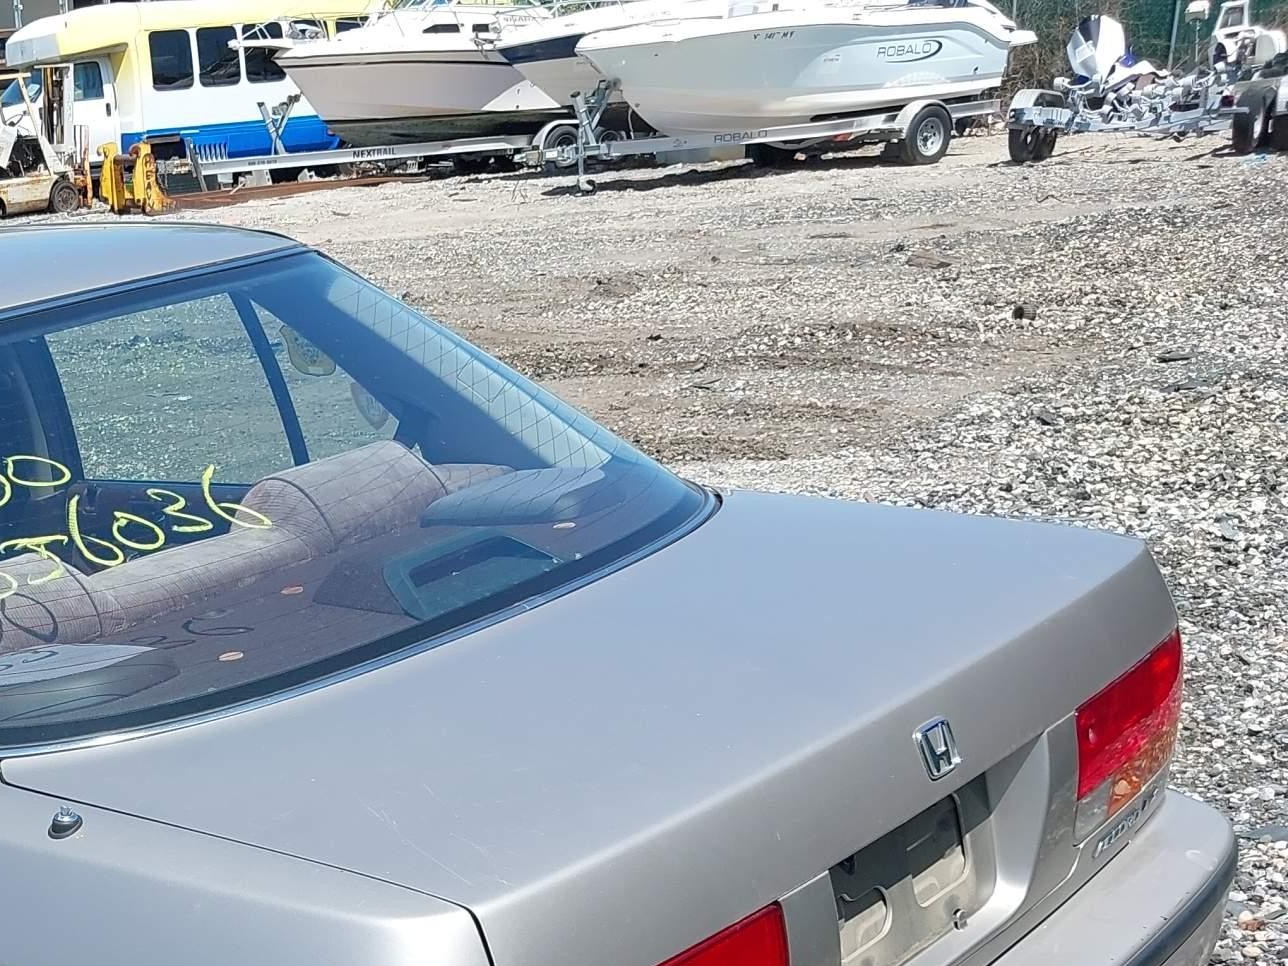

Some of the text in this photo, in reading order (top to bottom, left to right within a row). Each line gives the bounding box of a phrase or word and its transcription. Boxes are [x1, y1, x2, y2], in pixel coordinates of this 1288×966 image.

[877, 43, 931, 58] ROBALO
[714, 130, 768, 143] ROBALO
[352, 147, 397, 159] NEXTRAIL
